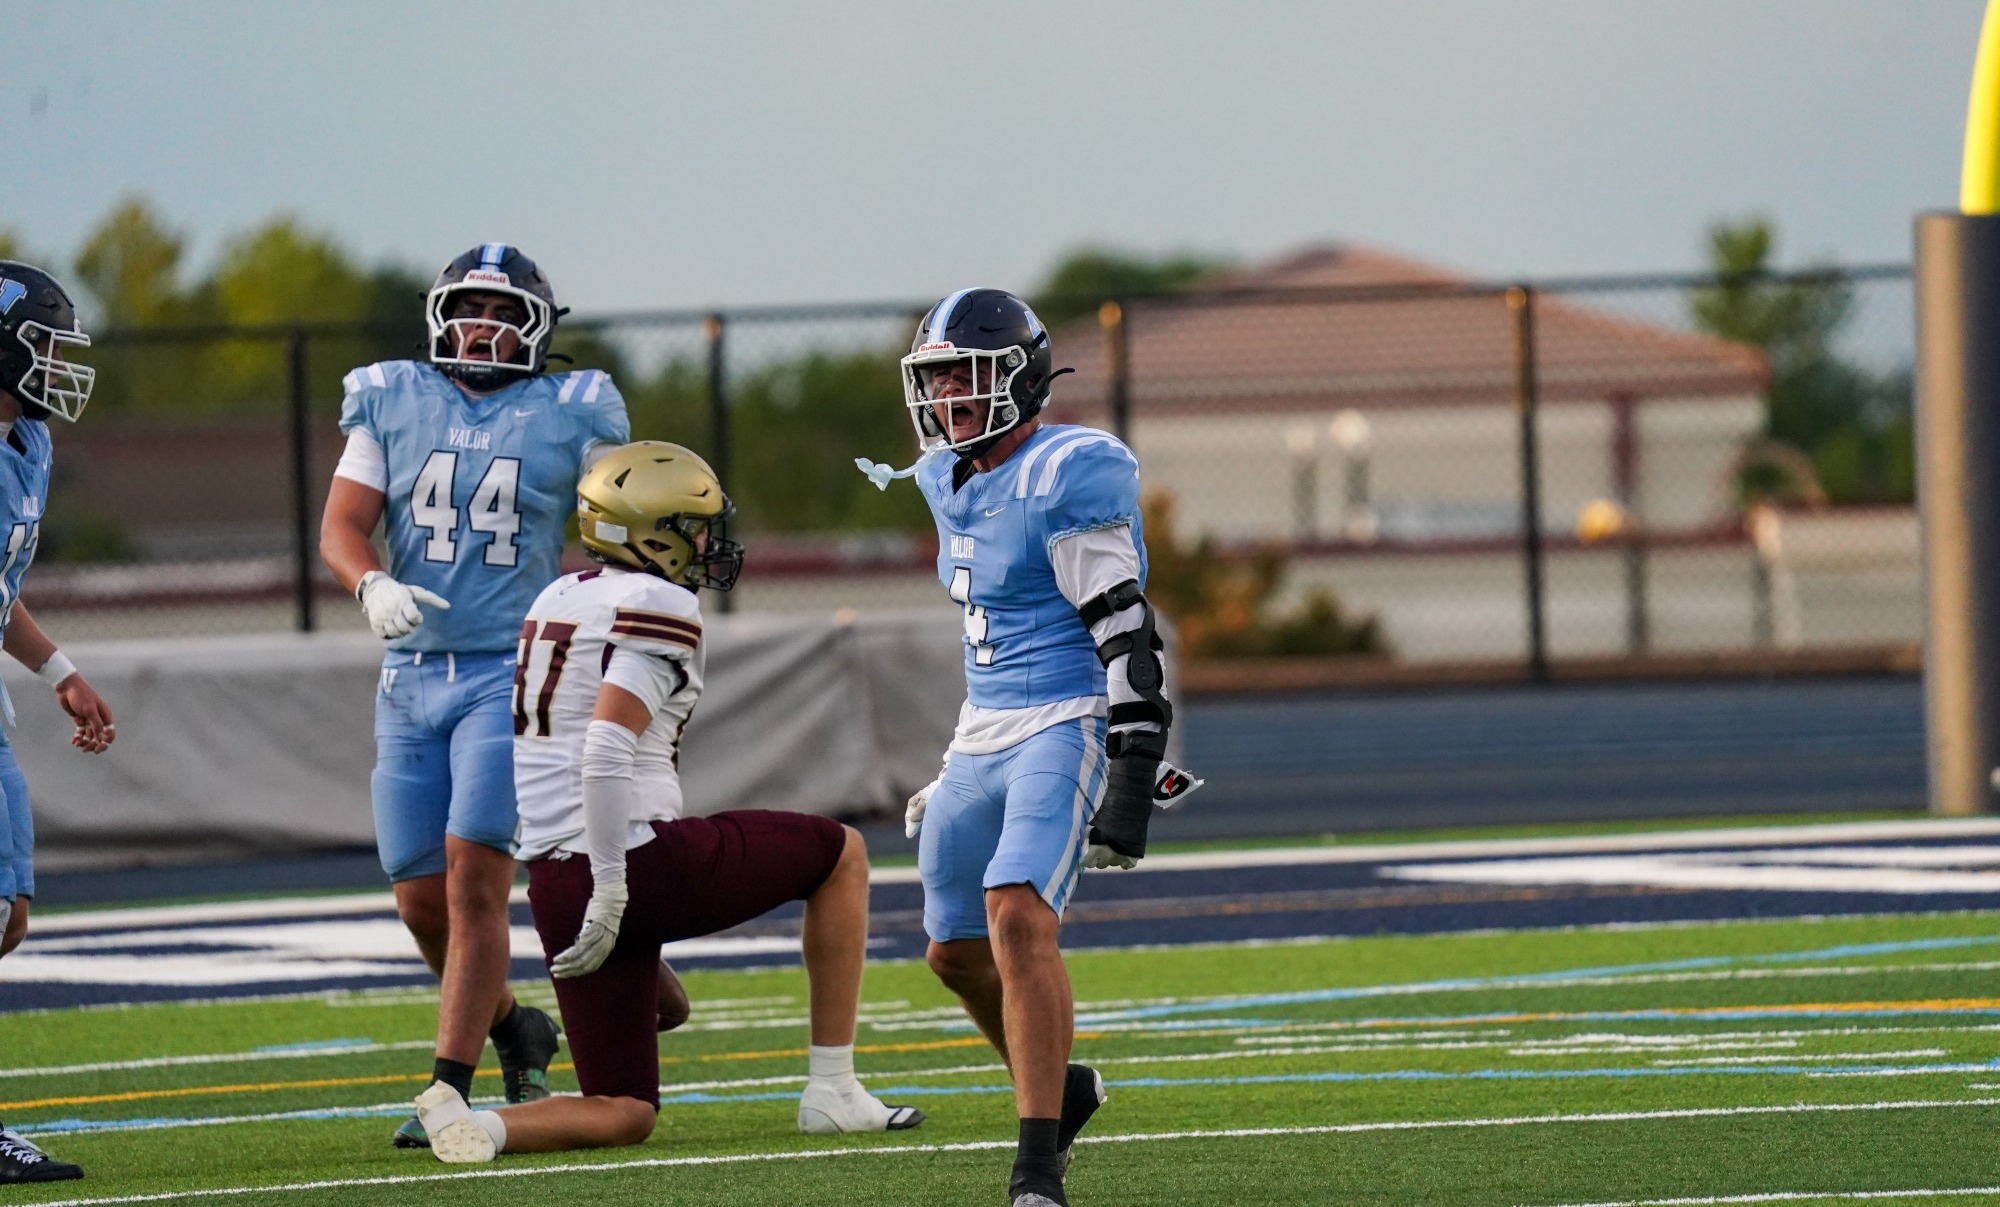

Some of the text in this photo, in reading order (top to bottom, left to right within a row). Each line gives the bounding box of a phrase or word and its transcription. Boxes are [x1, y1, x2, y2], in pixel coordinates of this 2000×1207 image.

[468, 272, 506, 284] Riddell
[449, 427, 491, 450] VALOR
[410, 449, 523, 569] 44
[949, 566, 996, 667] 4
